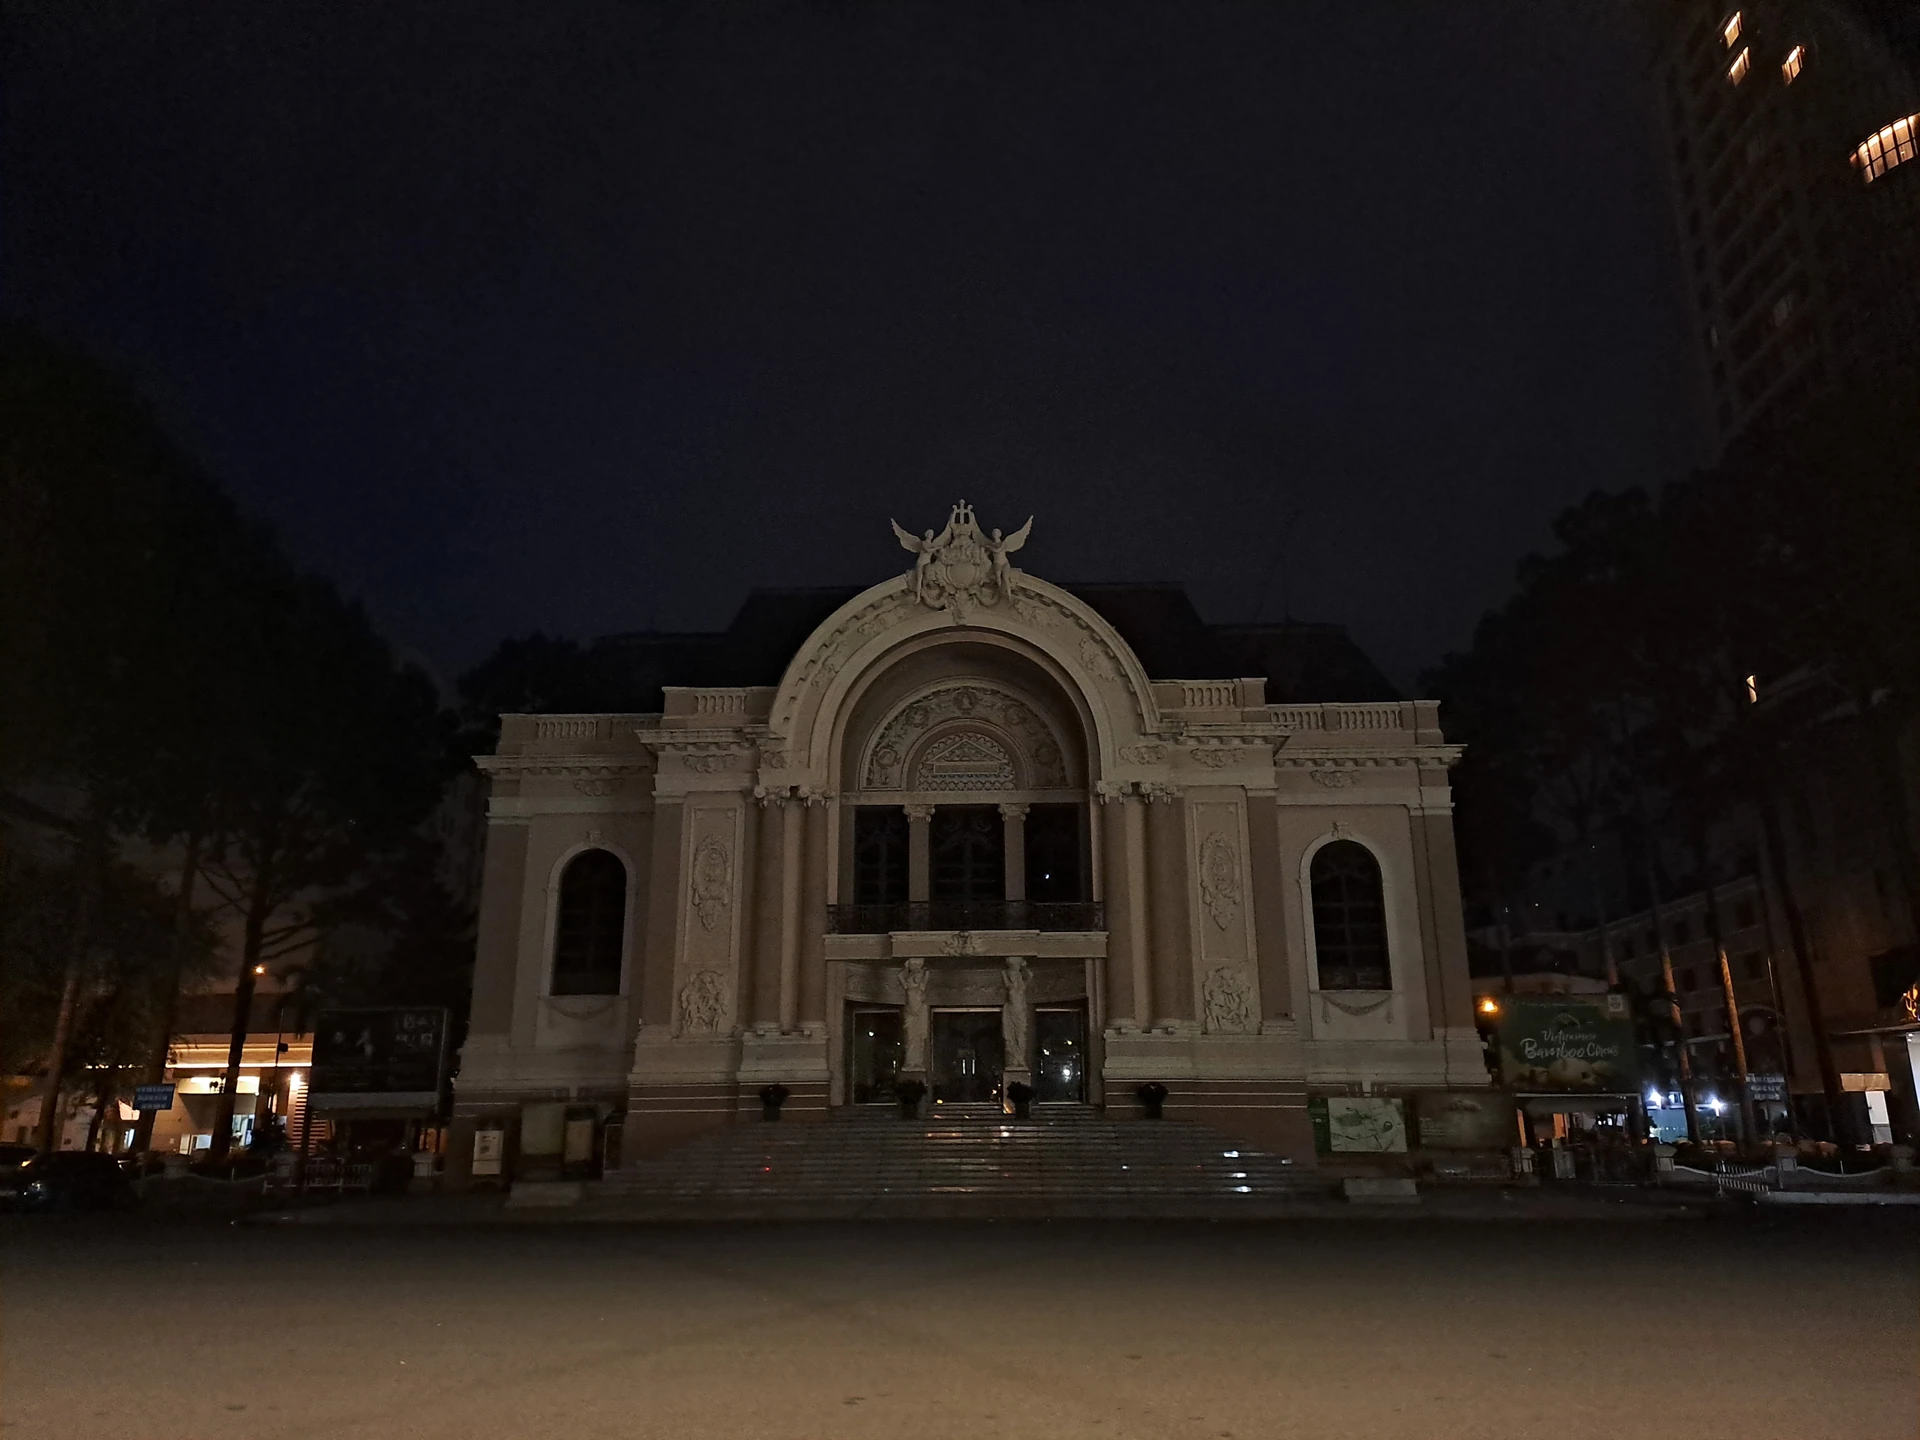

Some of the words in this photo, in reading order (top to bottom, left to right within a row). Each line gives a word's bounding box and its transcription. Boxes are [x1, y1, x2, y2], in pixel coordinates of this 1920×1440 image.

[1541, 1028, 1597, 1044] Vietnamese
[1520, 1038, 1586, 1059] Bamboo
[1586, 1042, 1619, 1058] Circus
